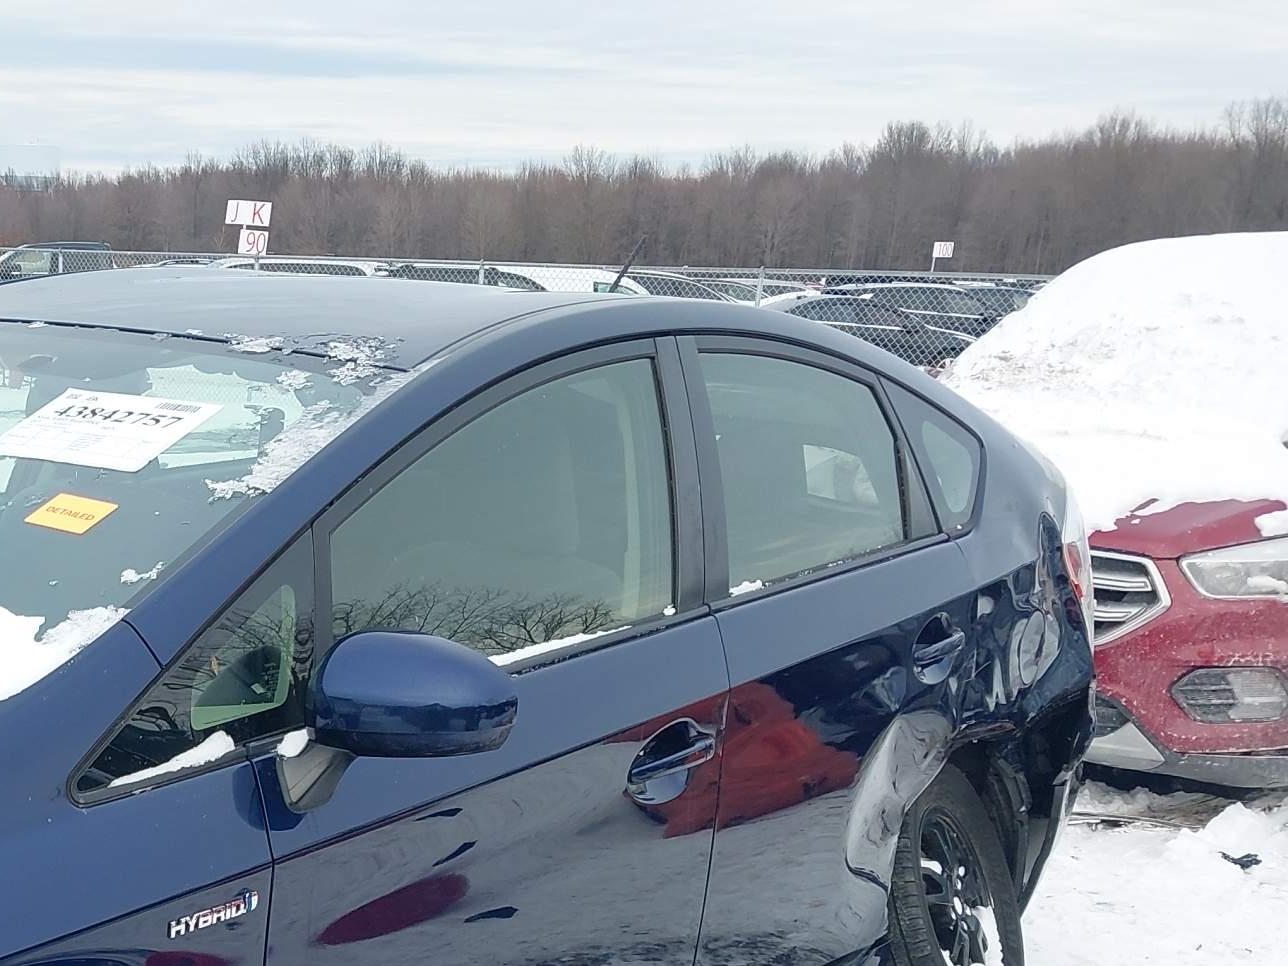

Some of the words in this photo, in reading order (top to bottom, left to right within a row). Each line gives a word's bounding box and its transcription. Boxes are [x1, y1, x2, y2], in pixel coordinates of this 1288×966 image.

[230, 201, 240, 223] J
[252, 202, 266, 225] K
[246, 231, 267, 254] 90
[938, 243, 953, 257] 100
[54, 405, 184, 429] 43842757
[46, 506, 96, 521] DETAILED
[168, 898, 248, 939] HYBRID
